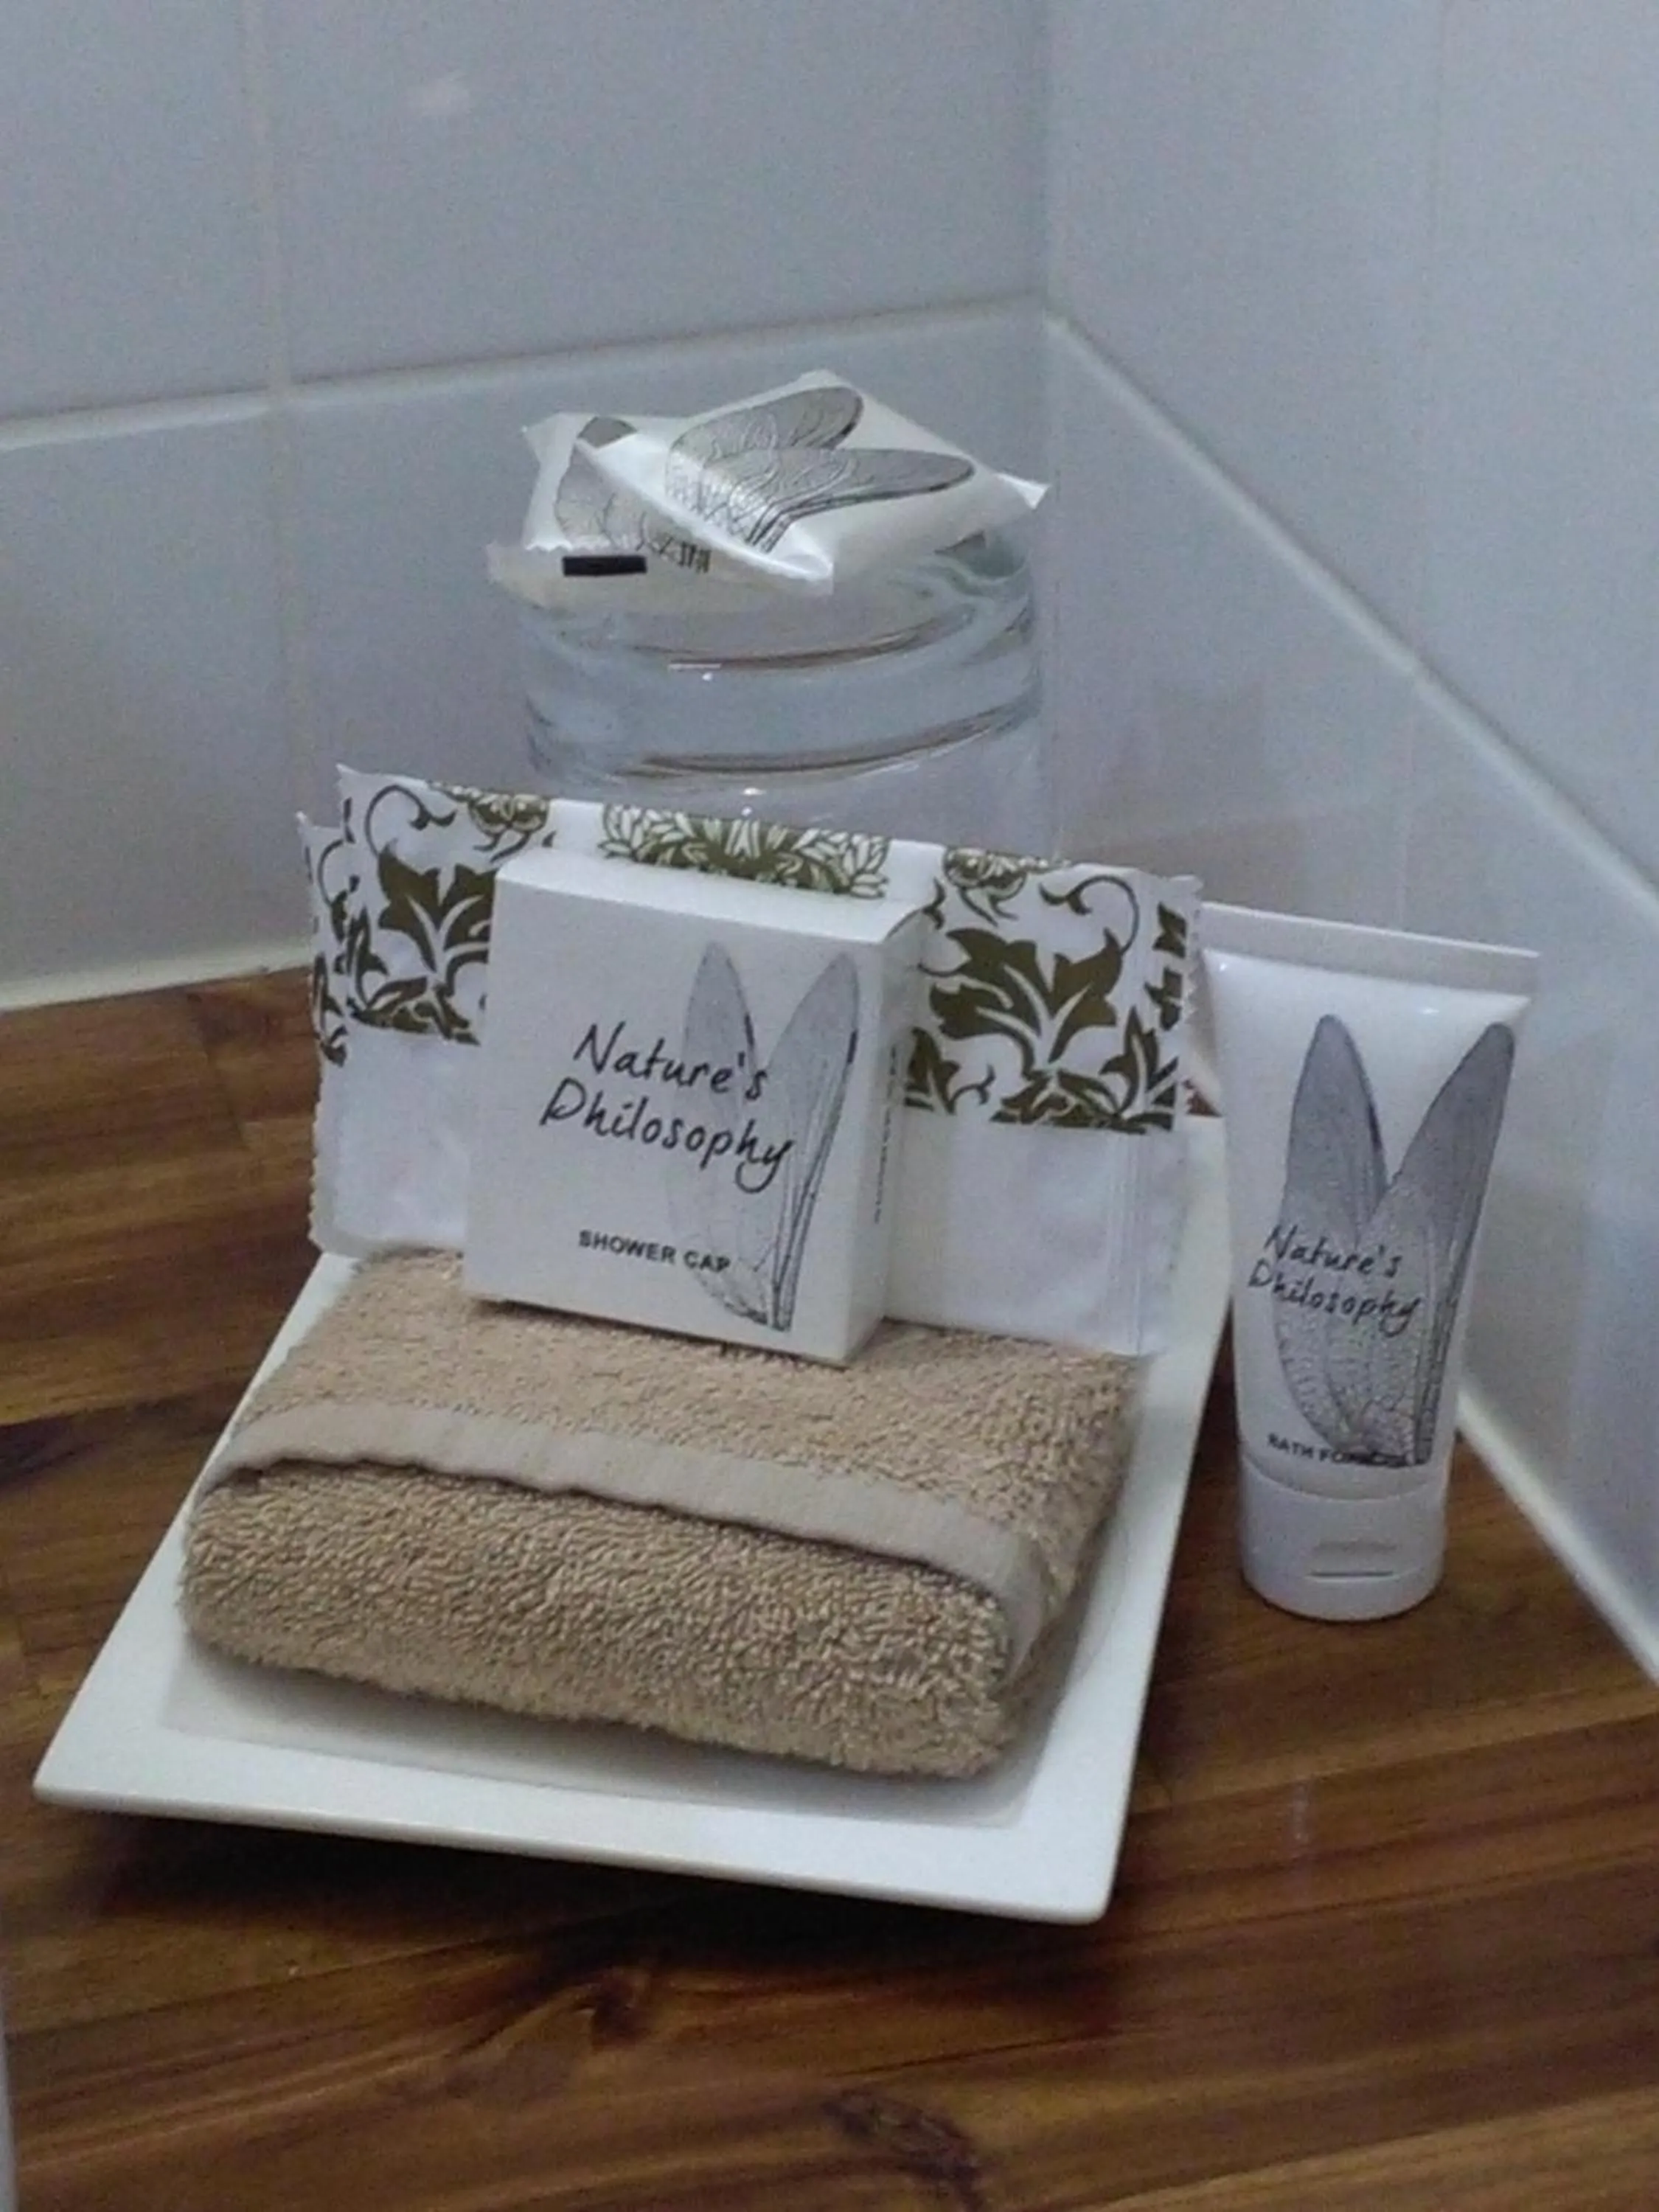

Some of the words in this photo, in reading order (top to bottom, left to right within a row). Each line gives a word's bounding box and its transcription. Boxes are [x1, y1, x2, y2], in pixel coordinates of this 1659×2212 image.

[572, 1020, 768, 1099] Nature's
[539, 1077, 794, 1193] Philosophy
[579, 1229, 677, 1265] SHOWER
[684, 1250, 731, 1273] CAP
[1263, 1223, 1401, 1278] Nature's
[1248, 1259, 1421, 1339] Philosophy
